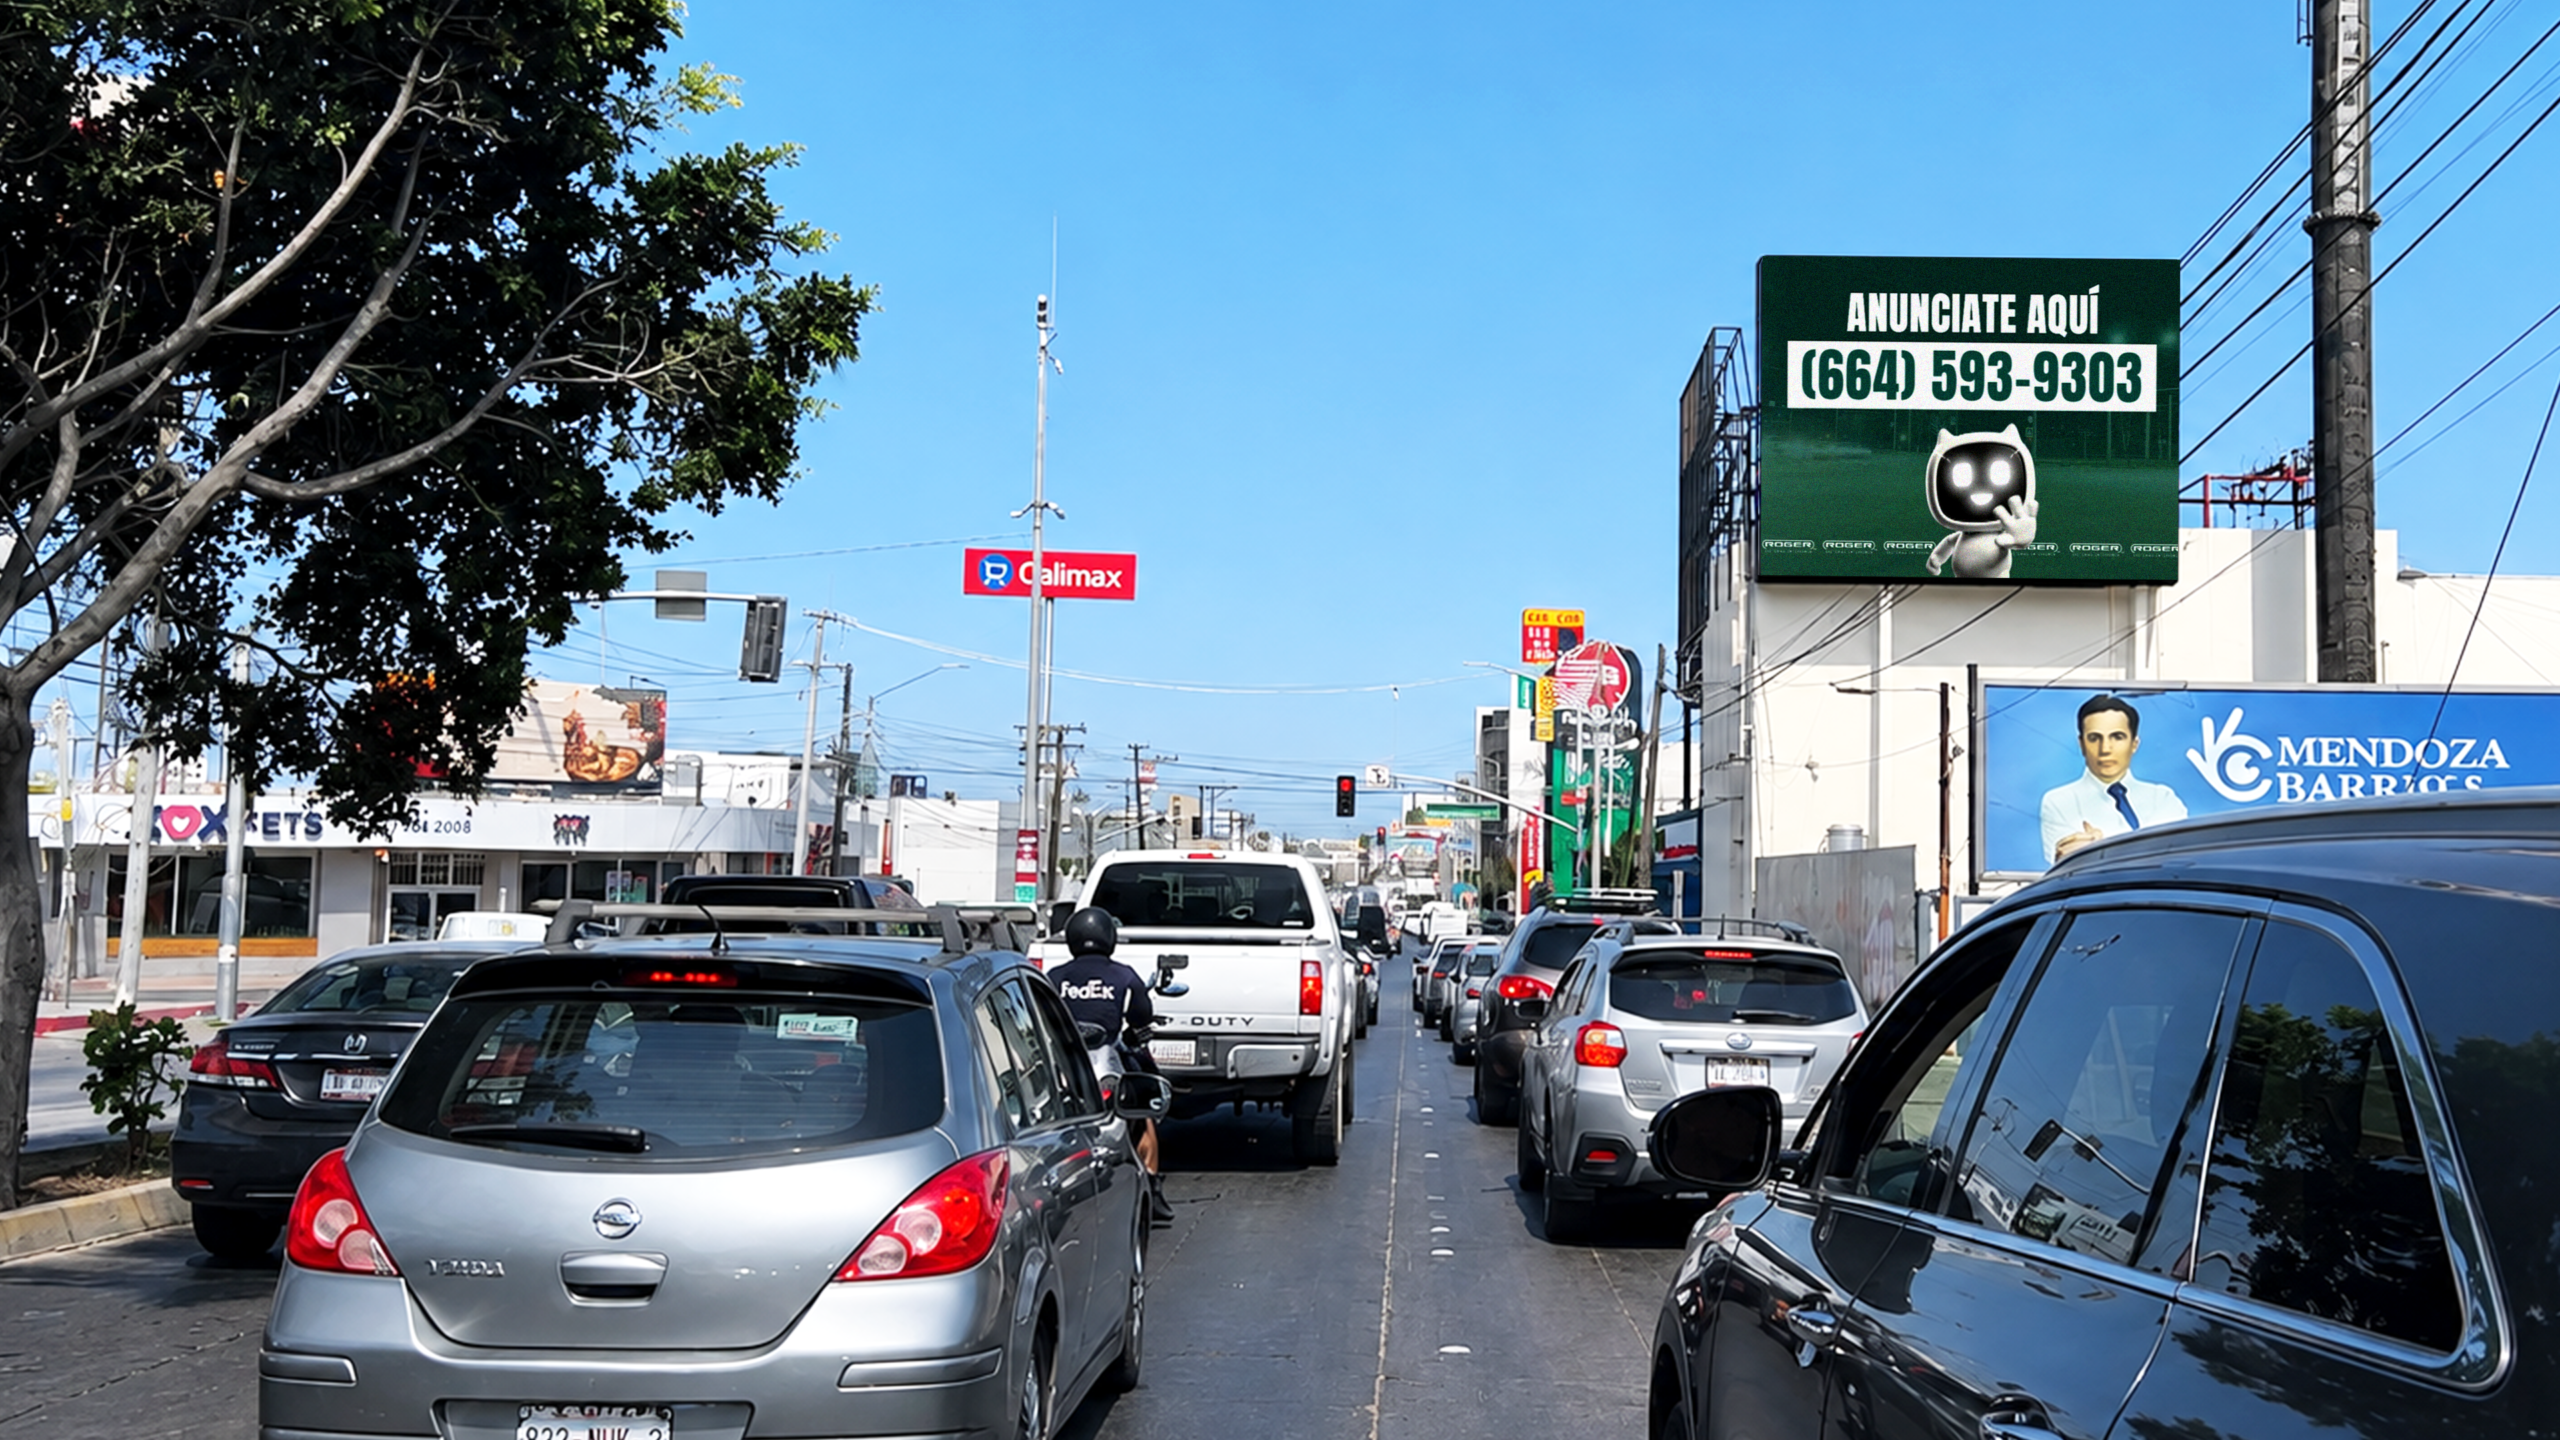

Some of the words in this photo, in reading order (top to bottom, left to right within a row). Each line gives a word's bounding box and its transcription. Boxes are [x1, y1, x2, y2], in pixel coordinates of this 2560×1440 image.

[1847, 292, 2017, 333] ANUNCIATE
[2027, 284, 2100, 337] AQUÍ
[1801, 348, 1916, 401] (664)
[1931, 350, 2142, 403] 593-9303
[1018, 561, 1123, 588] Calimax
[2277, 736, 2511, 769] MENDOZA
[433, 820, 472, 834] 2008
[1191, 1016, 1254, 1026] DUTY
